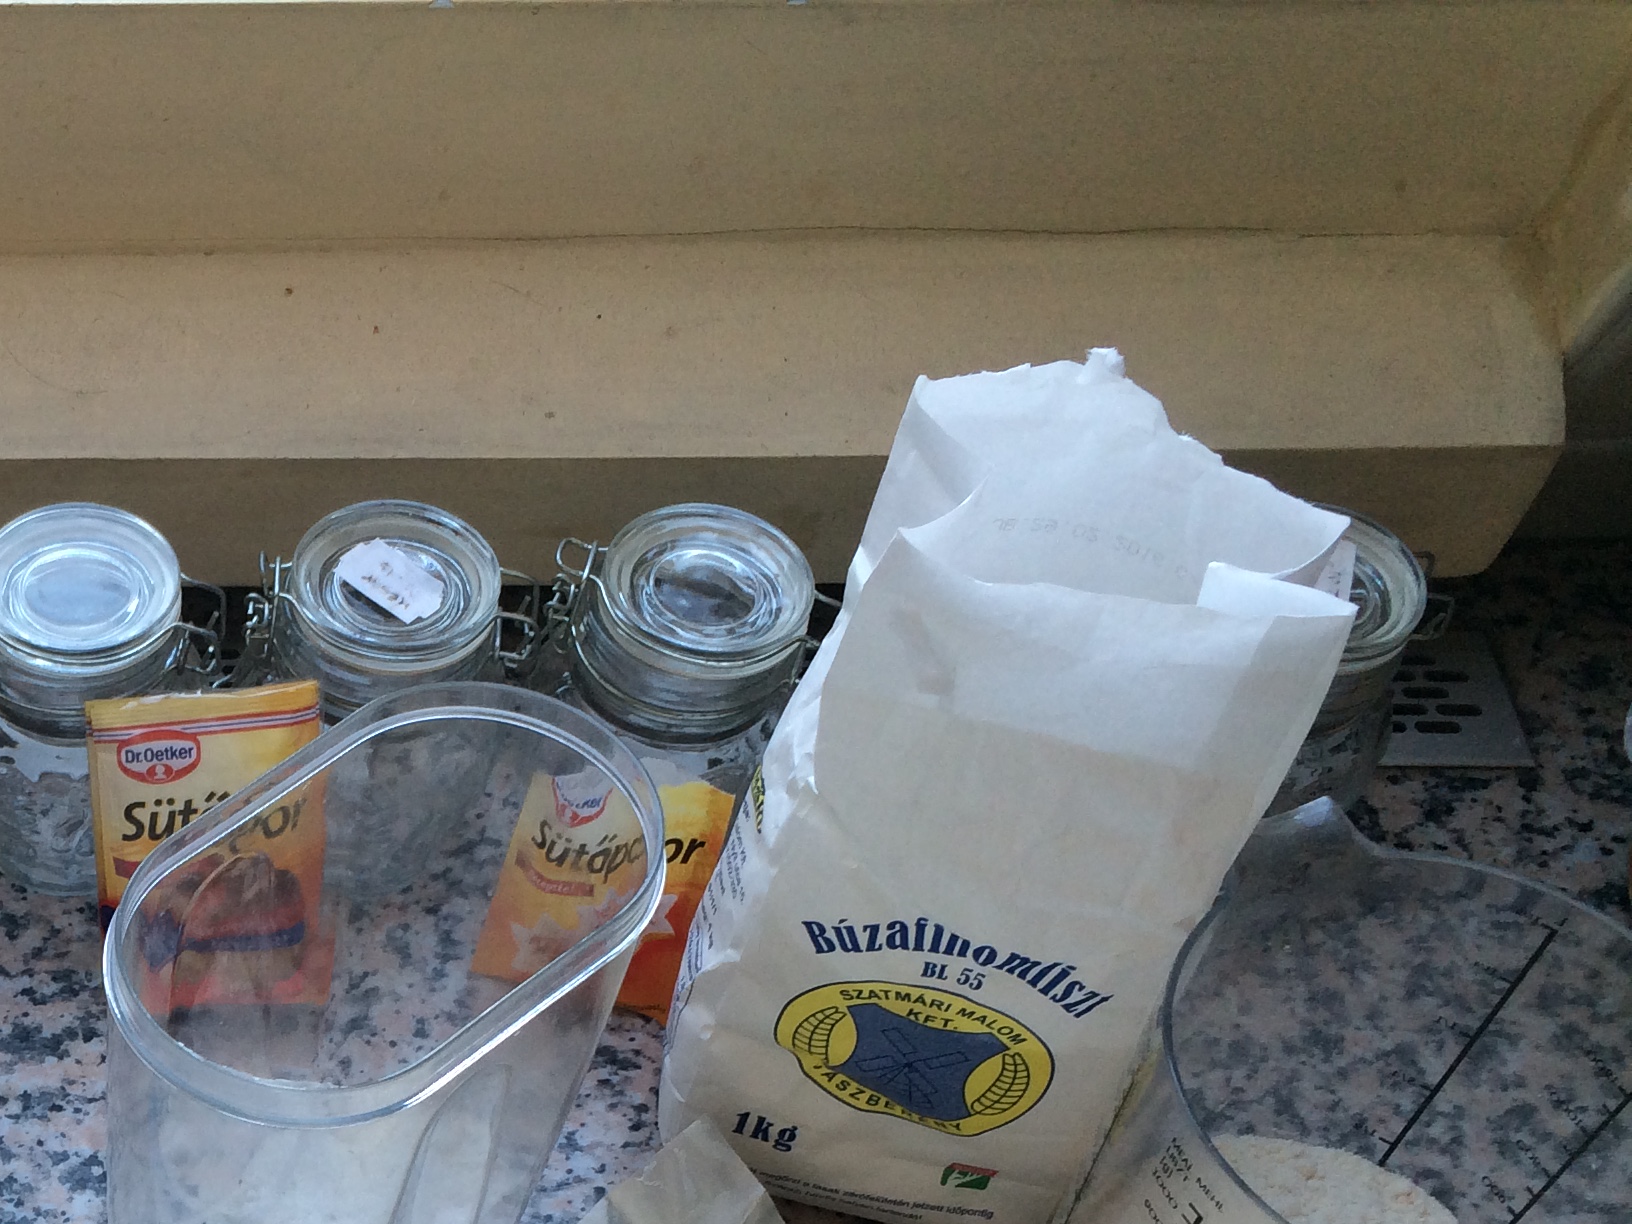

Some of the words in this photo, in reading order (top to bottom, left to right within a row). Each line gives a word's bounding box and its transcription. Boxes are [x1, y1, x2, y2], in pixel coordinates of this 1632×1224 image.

[801, 917, 1115, 1019] Búzafinomliszt
[920, 961, 948, 981] BL
[956, 967, 986, 992] 55
[839, 989, 953, 1013] SZATMÁRI
[955, 1006, 1029, 1047] MALOM
[905, 1007, 959, 1030] KFT.
